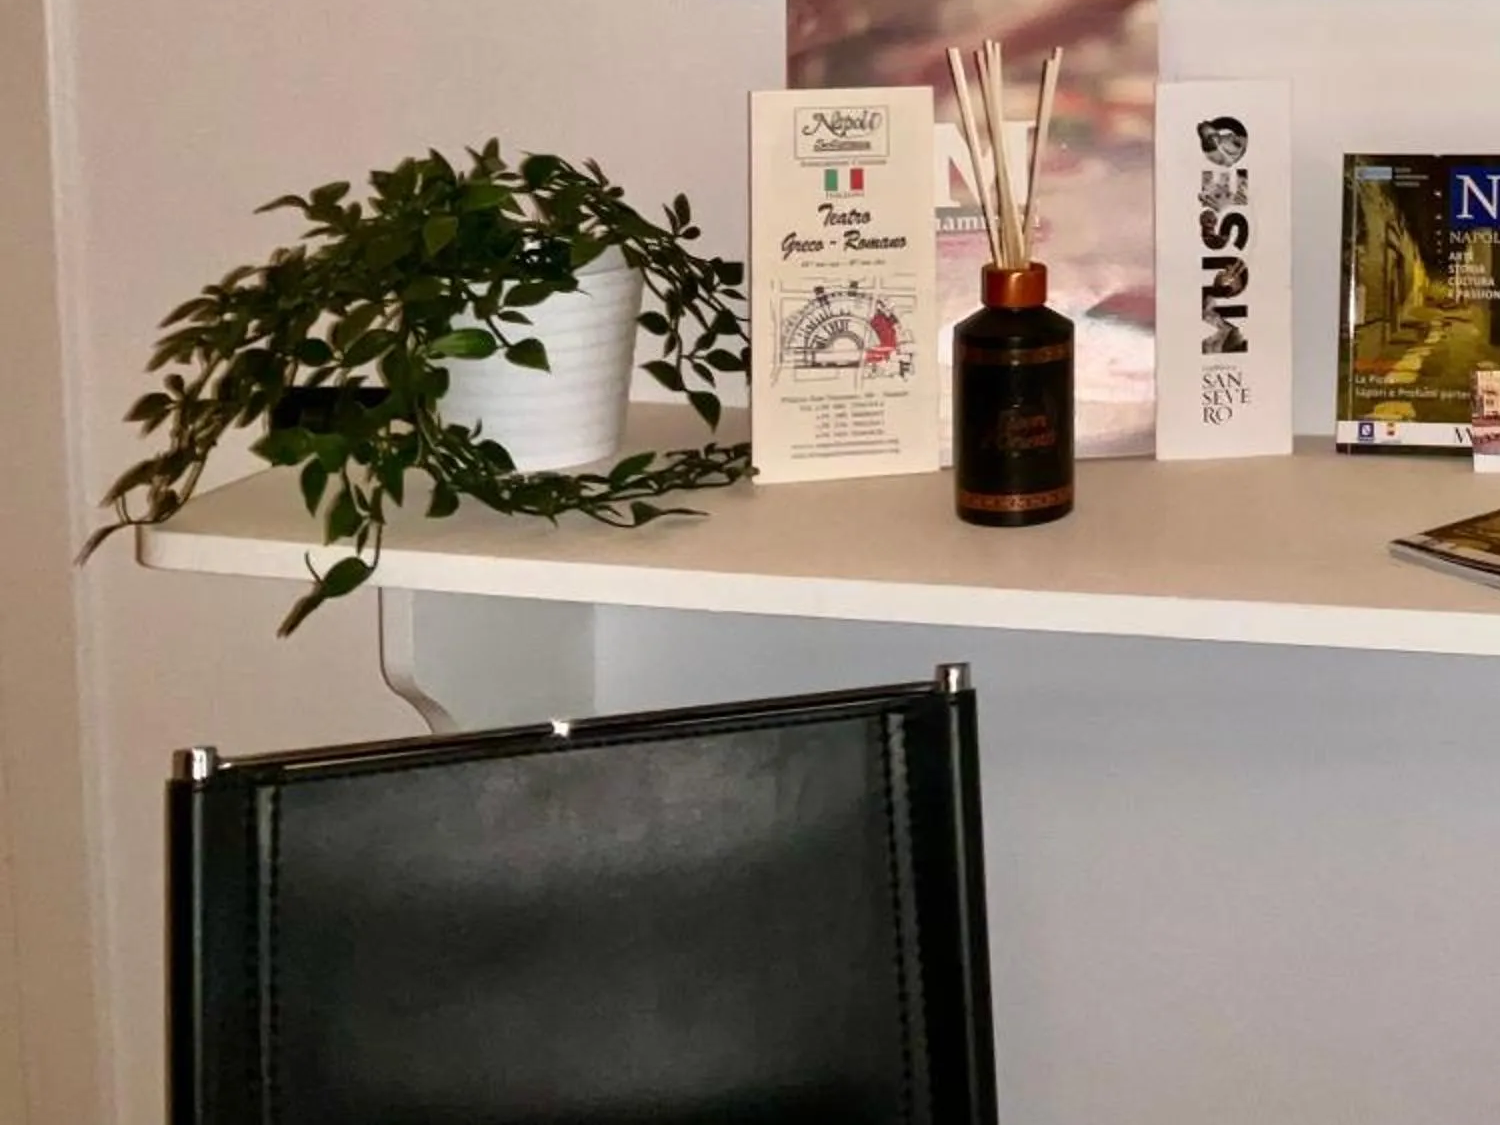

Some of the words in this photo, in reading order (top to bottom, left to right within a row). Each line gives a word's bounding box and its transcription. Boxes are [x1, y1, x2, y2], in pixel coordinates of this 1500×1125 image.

[818, 203, 872, 227] Teatro
[781, 231, 825, 261] Greco
[843, 229, 907, 252] Romano
[1196, 116, 1250, 355] MUSEO
[1201, 372, 1243, 390] SAN
[1202, 388, 1251, 406] SEVE
[1202, 406, 1234, 425] RO
